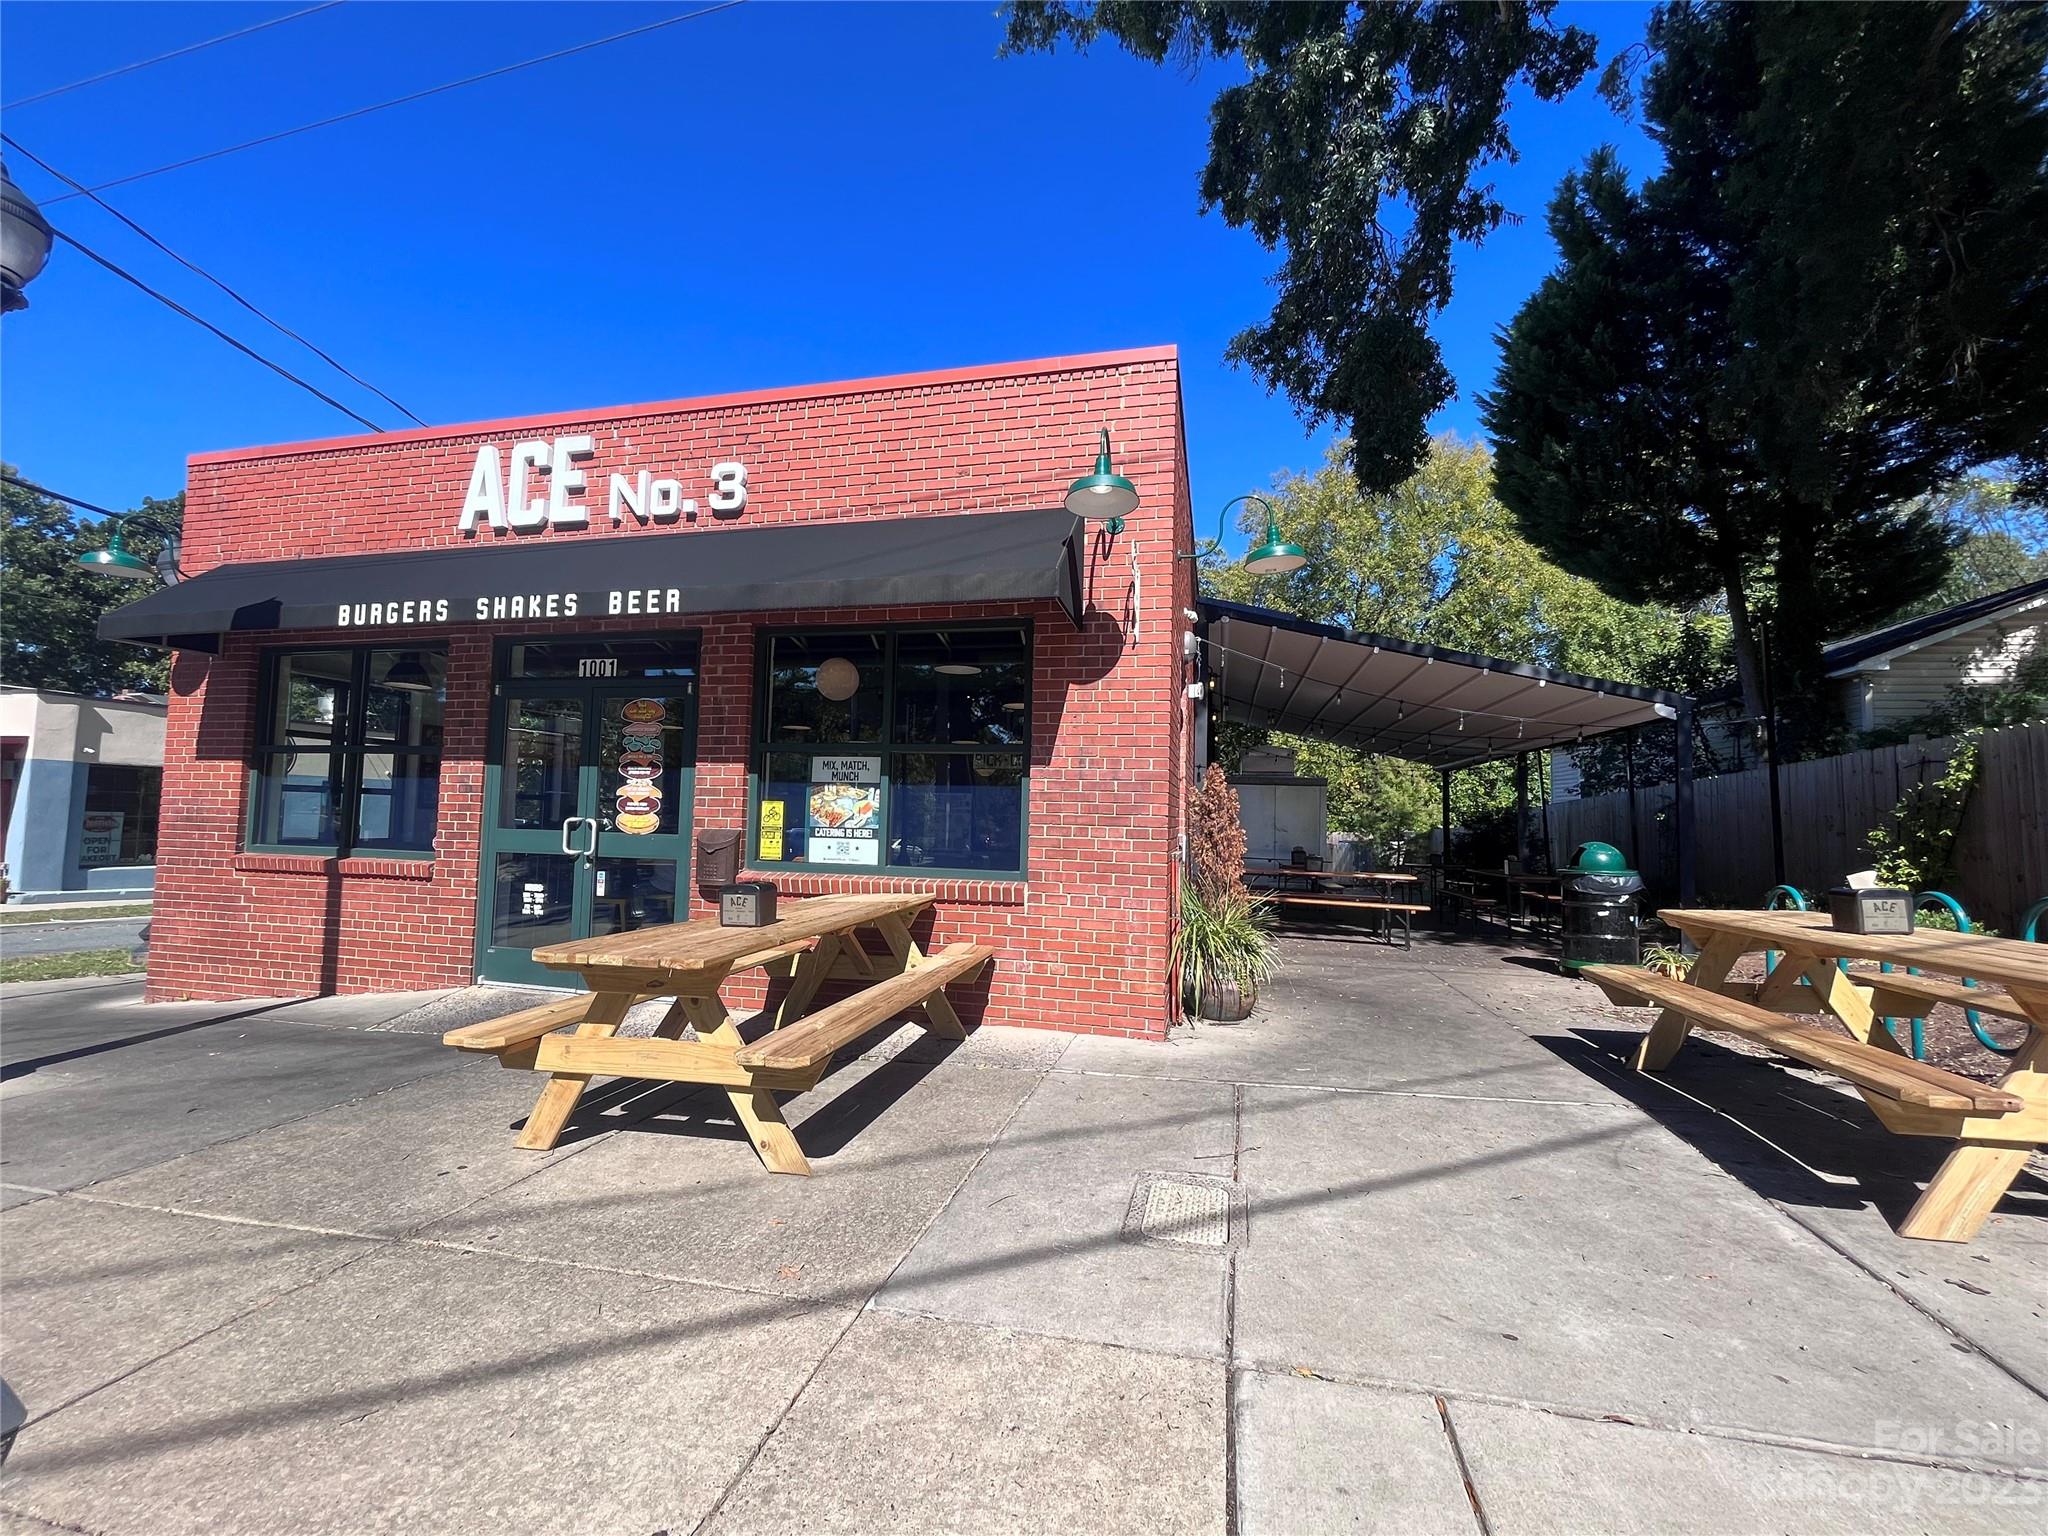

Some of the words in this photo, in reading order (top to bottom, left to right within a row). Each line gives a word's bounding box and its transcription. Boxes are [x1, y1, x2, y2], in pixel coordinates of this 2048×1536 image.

[458, 435, 594, 534] ACE
[608, 470, 698, 523] No.
[708, 462, 748, 515] 3
[338, 599, 448, 626] BURGERS
[476, 593, 578, 620] SHAKES
[608, 588, 681, 615] BEER
[580, 659, 617, 677] 1001
[822, 760, 839, 771] MIX,
[840, 760, 870, 772] MATCH,
[831, 771, 860, 781] MUNCH
[814, 828, 845, 837] CATERING
[846, 829, 853, 838] IS
[853, 829, 873, 838] HERE!
[84, 837, 111, 846] OPEN
[730, 896, 749, 908] ACE
[1873, 901, 1897, 912] ACE
